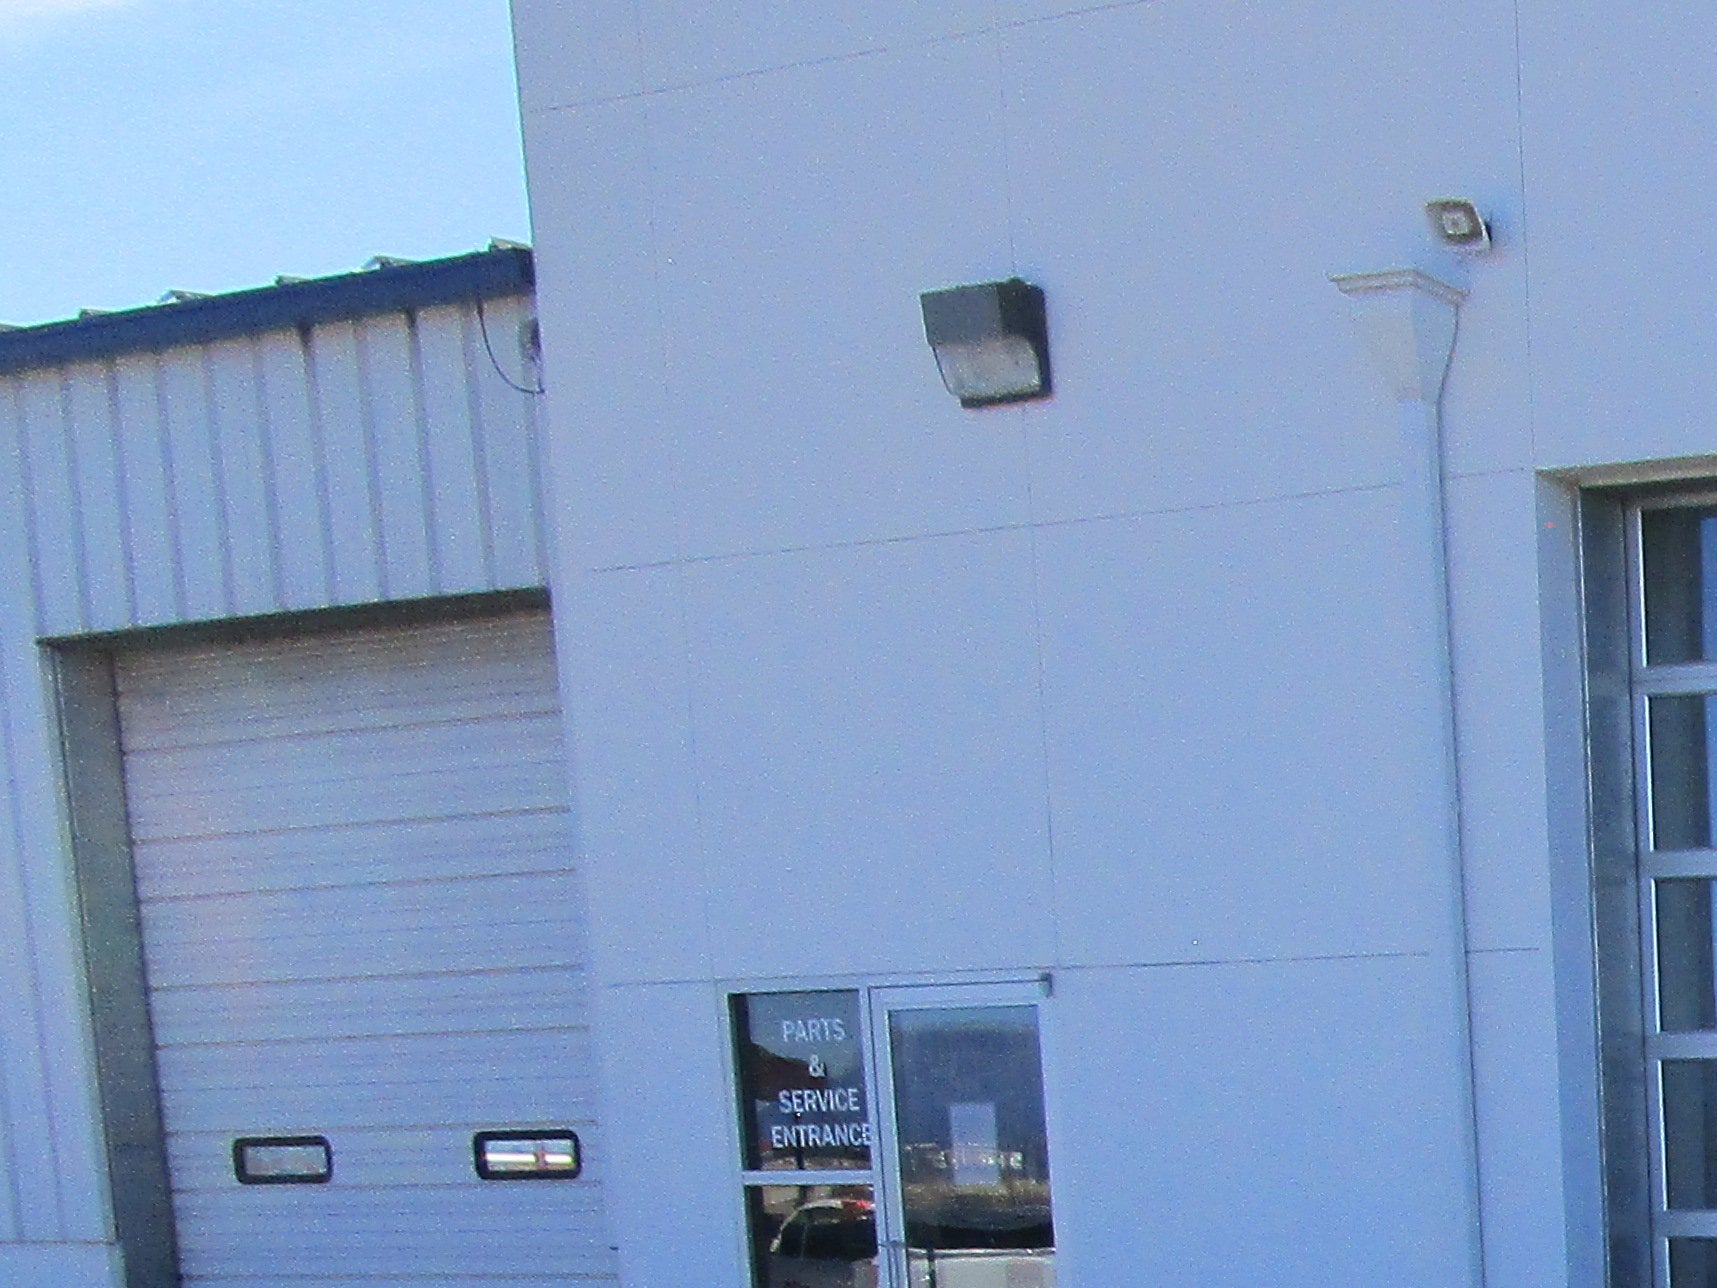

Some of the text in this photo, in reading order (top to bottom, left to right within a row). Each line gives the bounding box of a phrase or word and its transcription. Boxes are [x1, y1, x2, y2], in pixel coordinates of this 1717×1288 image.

[782, 1018, 846, 1043] PARTS
[808, 1053, 826, 1078] &
[779, 1088, 861, 1114] SERVICE
[772, 1125, 873, 1149] ENTRANCE
